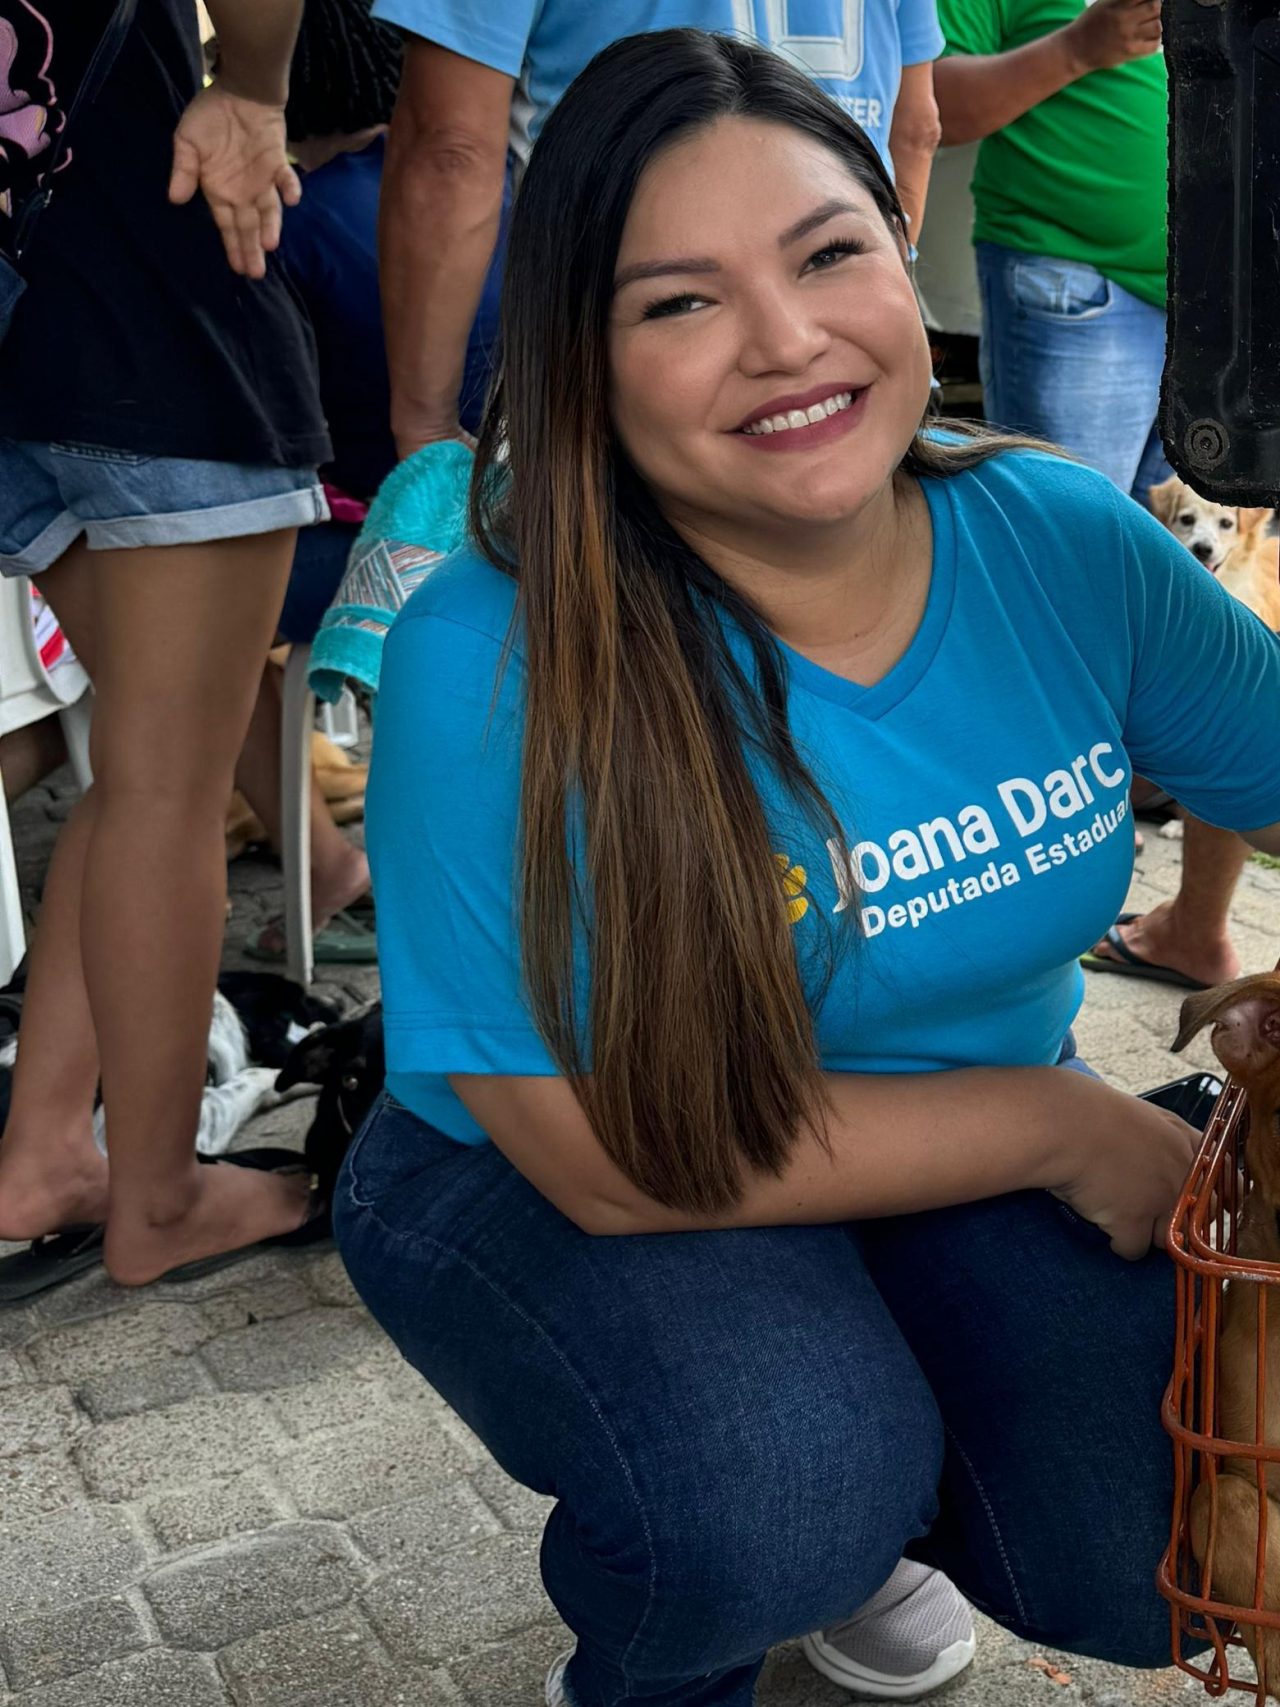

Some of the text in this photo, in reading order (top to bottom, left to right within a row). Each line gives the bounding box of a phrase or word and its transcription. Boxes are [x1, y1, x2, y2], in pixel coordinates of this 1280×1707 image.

[825, 742, 1125, 914] Joana Darc
[861, 788, 1129, 938] Deputada Estadual
